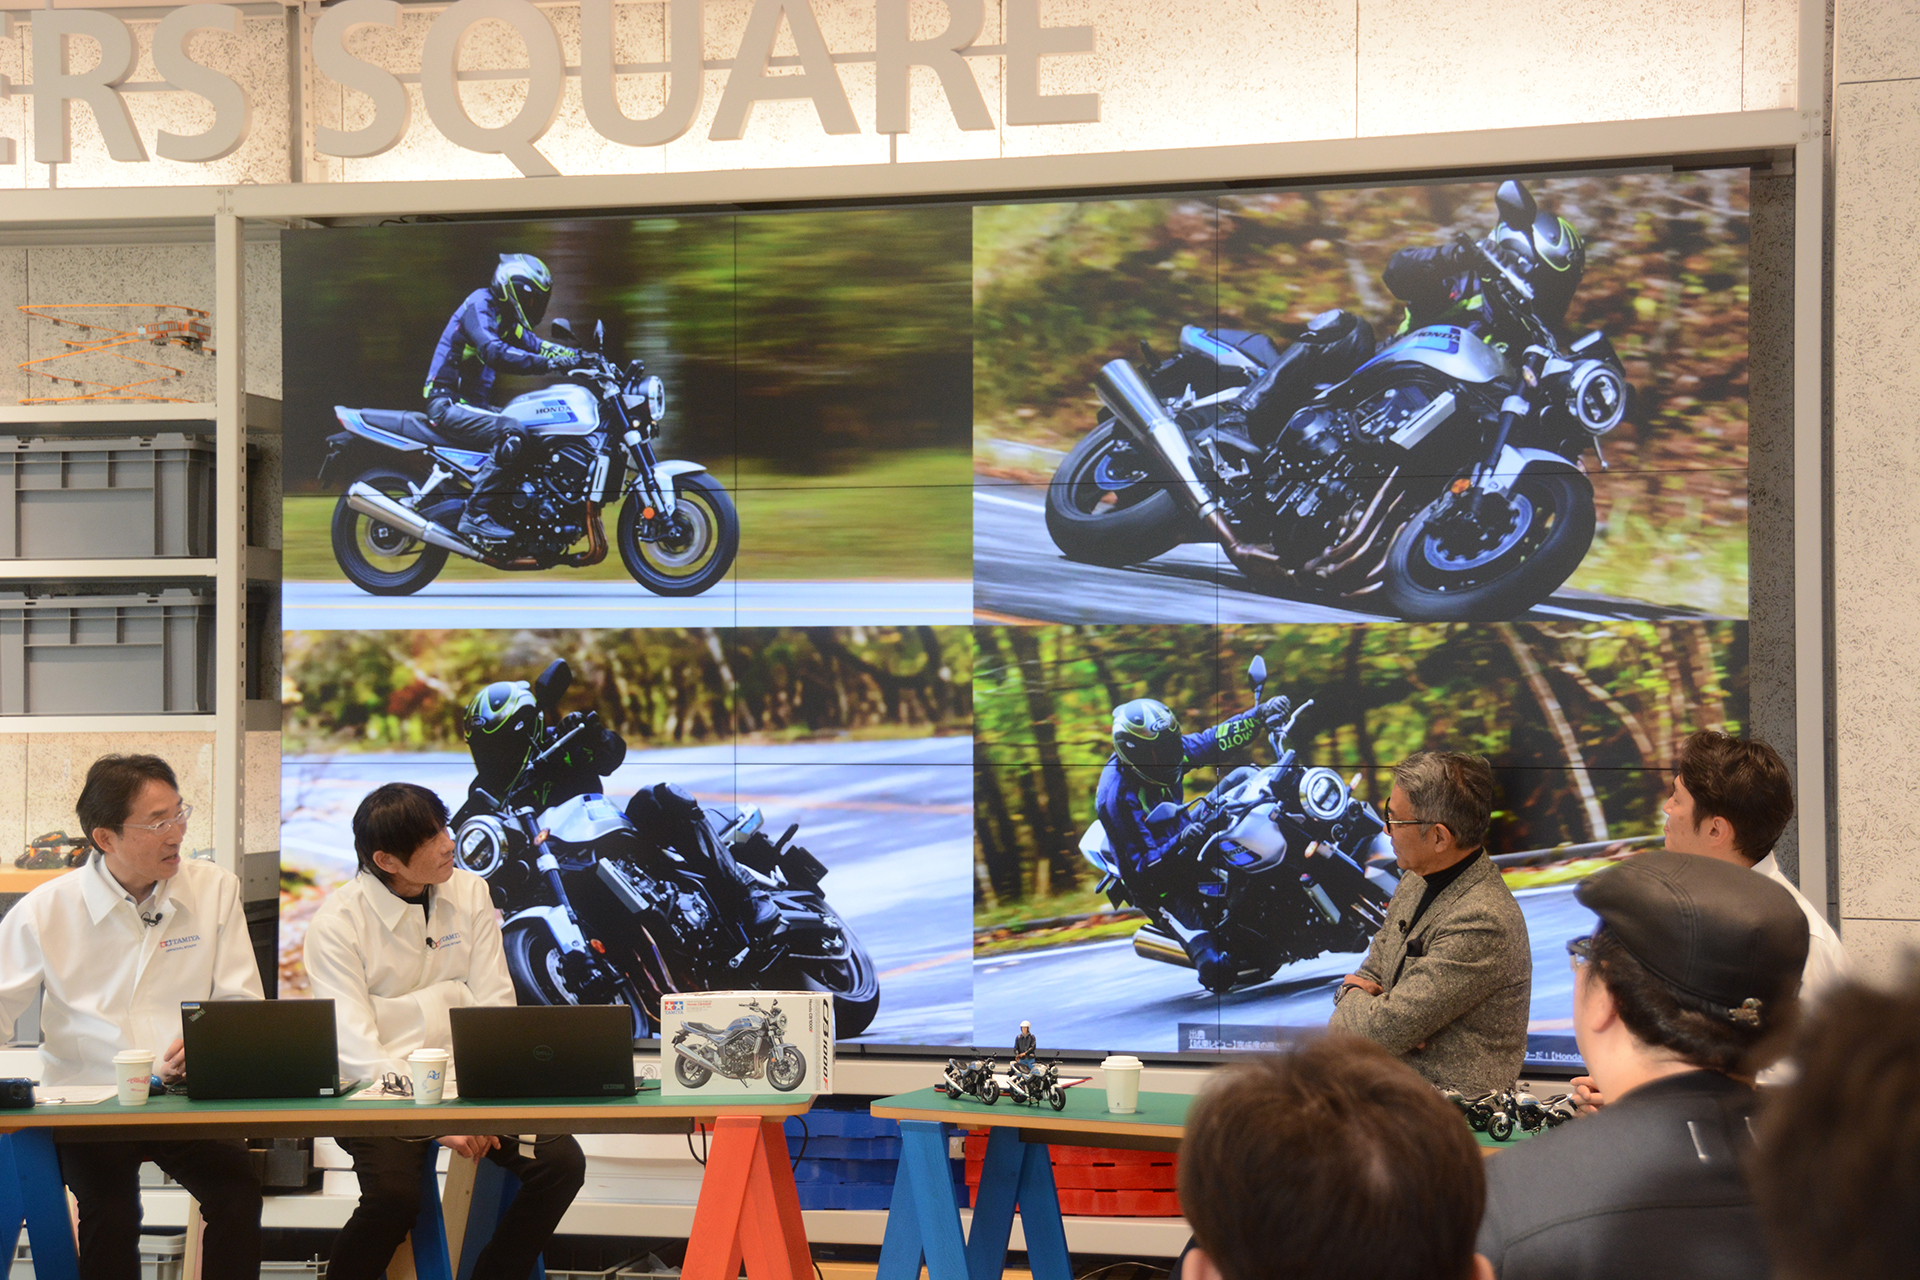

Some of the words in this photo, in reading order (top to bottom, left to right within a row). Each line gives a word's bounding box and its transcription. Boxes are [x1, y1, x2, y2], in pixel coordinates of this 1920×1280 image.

[0, 3, 252, 164] RS
[312, 0, 1102, 178] SQUARE
[1413, 331, 1461, 341] HONDA
[536, 405, 573, 415] HONDA
[173, 935, 200, 945] TAMIYA
